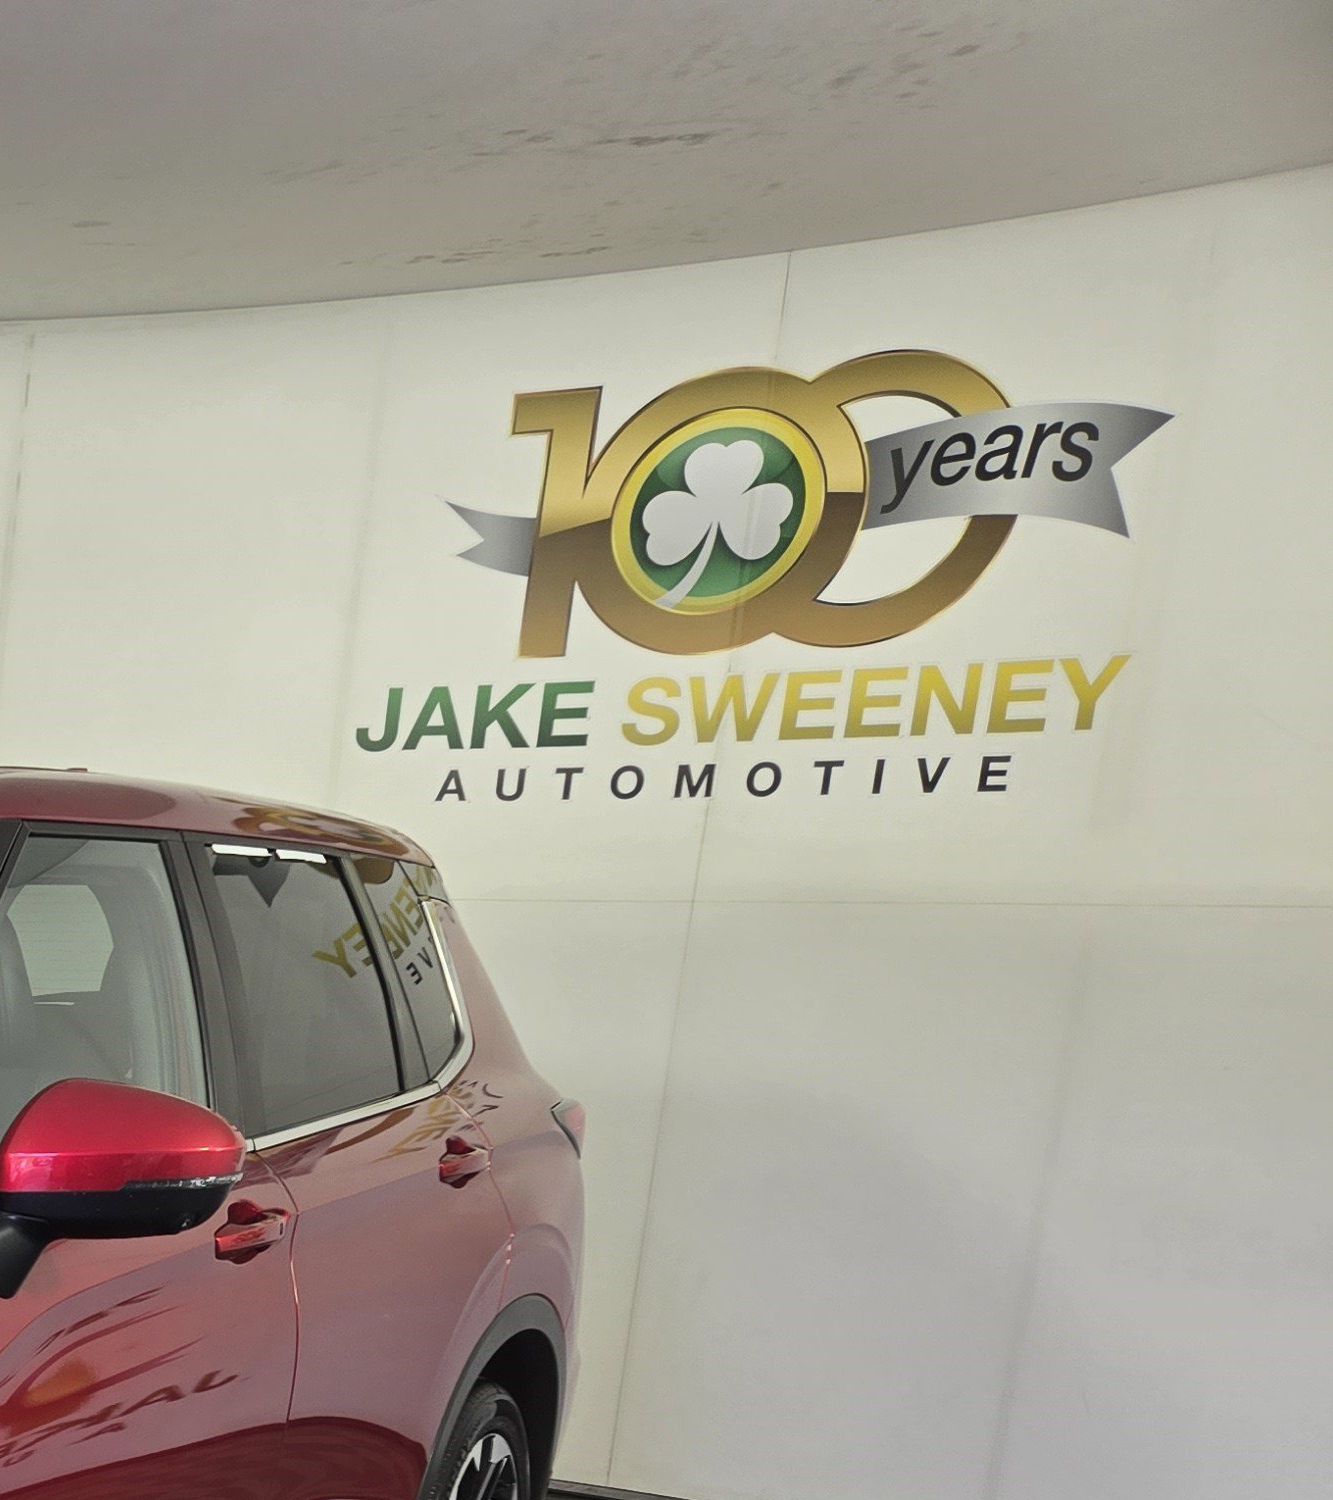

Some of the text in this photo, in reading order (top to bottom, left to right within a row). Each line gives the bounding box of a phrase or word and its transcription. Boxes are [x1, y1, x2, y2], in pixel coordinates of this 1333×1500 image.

[879, 419, 1099, 514] years
[355, 654, 1132, 753] JAKE SWEENEY
[435, 755, 1014, 803] AUTOMOTIVE
